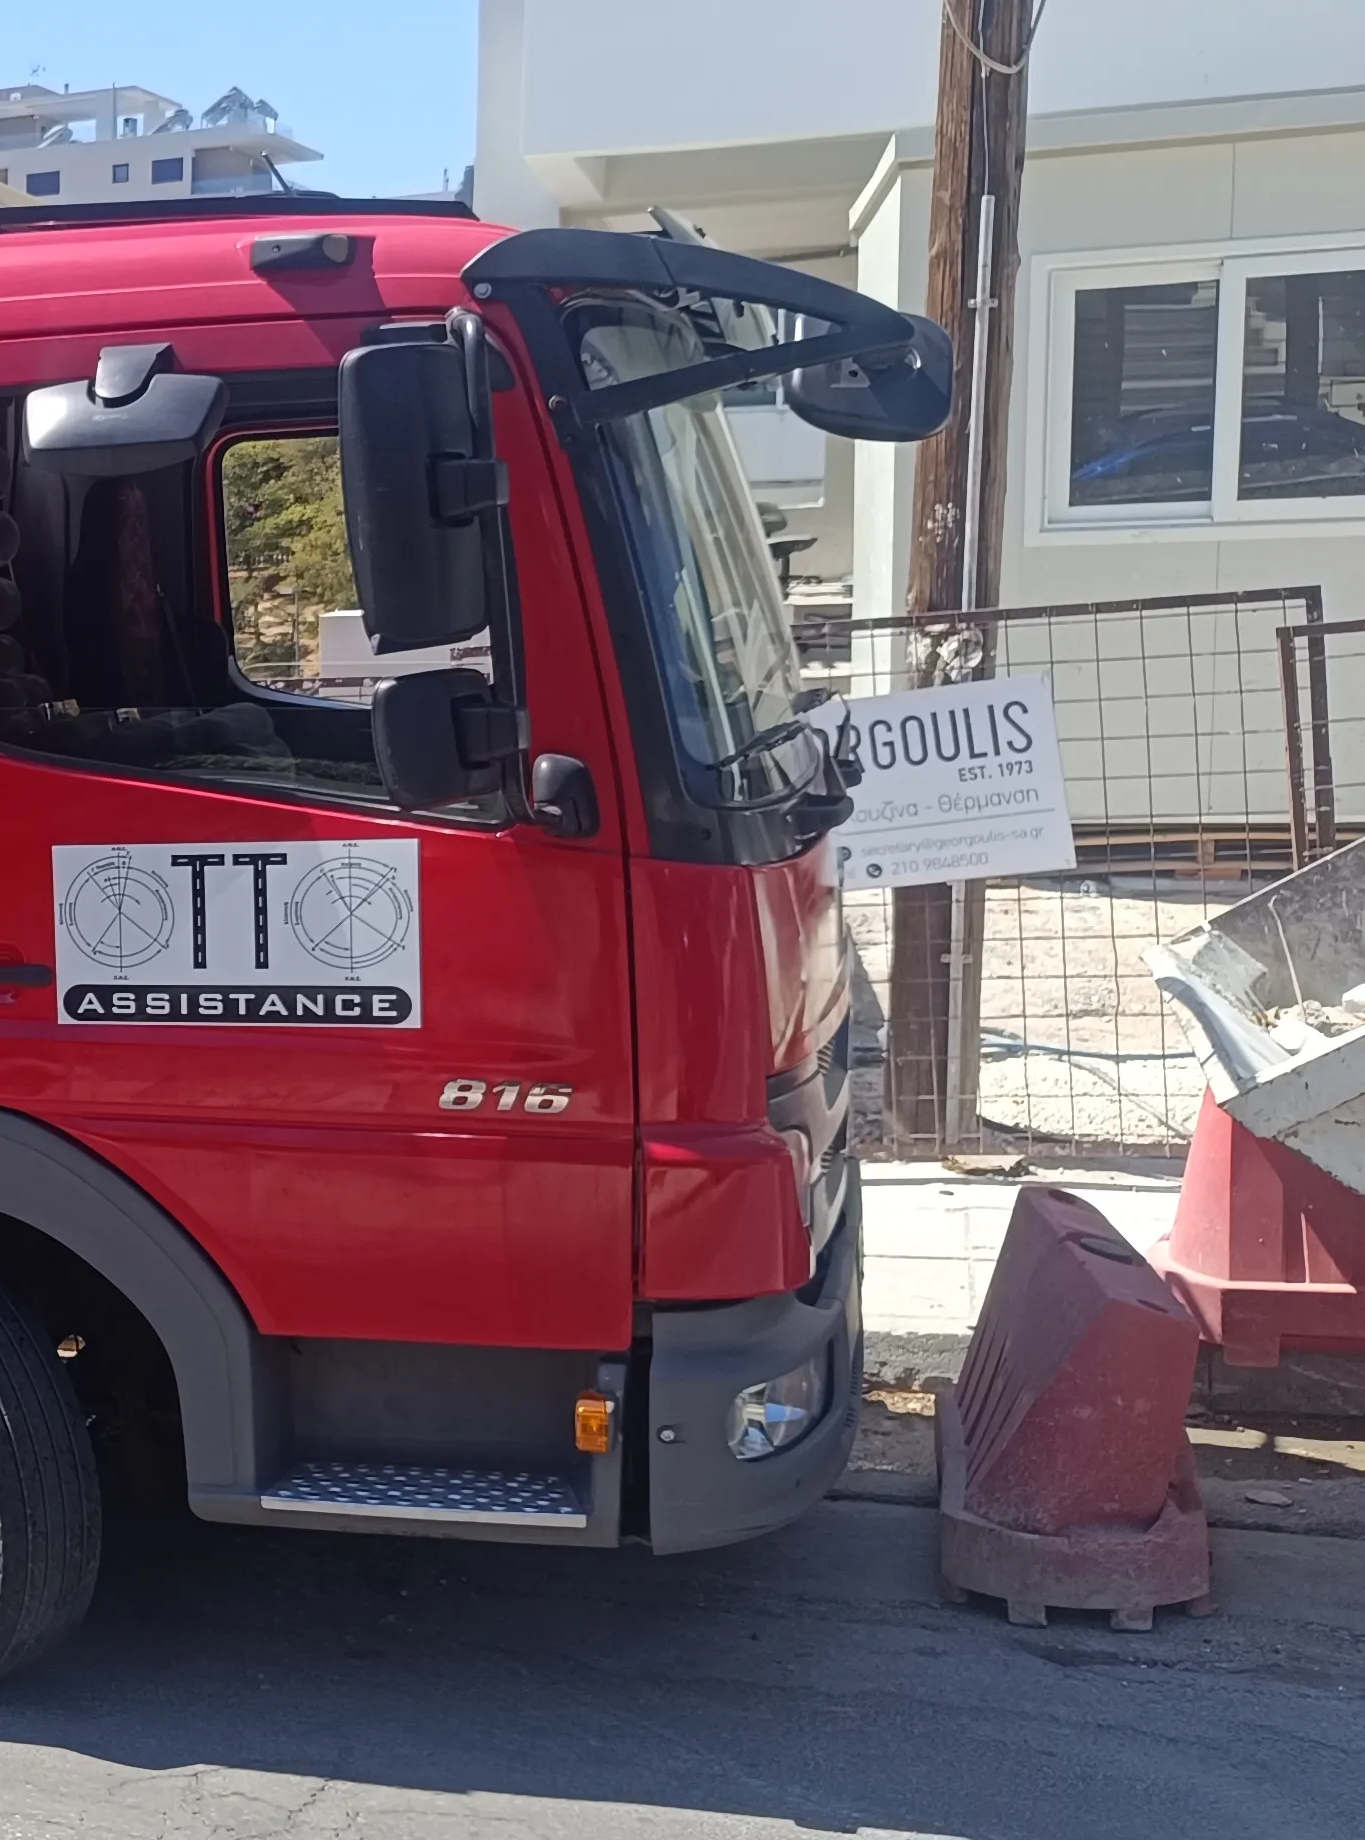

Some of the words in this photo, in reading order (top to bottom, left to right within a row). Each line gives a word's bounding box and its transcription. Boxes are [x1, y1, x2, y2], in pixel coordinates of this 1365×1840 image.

[957, 764, 993, 783] EST.
[997, 759, 1034, 778] 1973
[937, 787, 1039, 815] Θέρμανση
[891, 861, 919, 876] 210
[76, 991, 398, 1018] ASSISTANCE
[438, 1078, 573, 1114] 816
